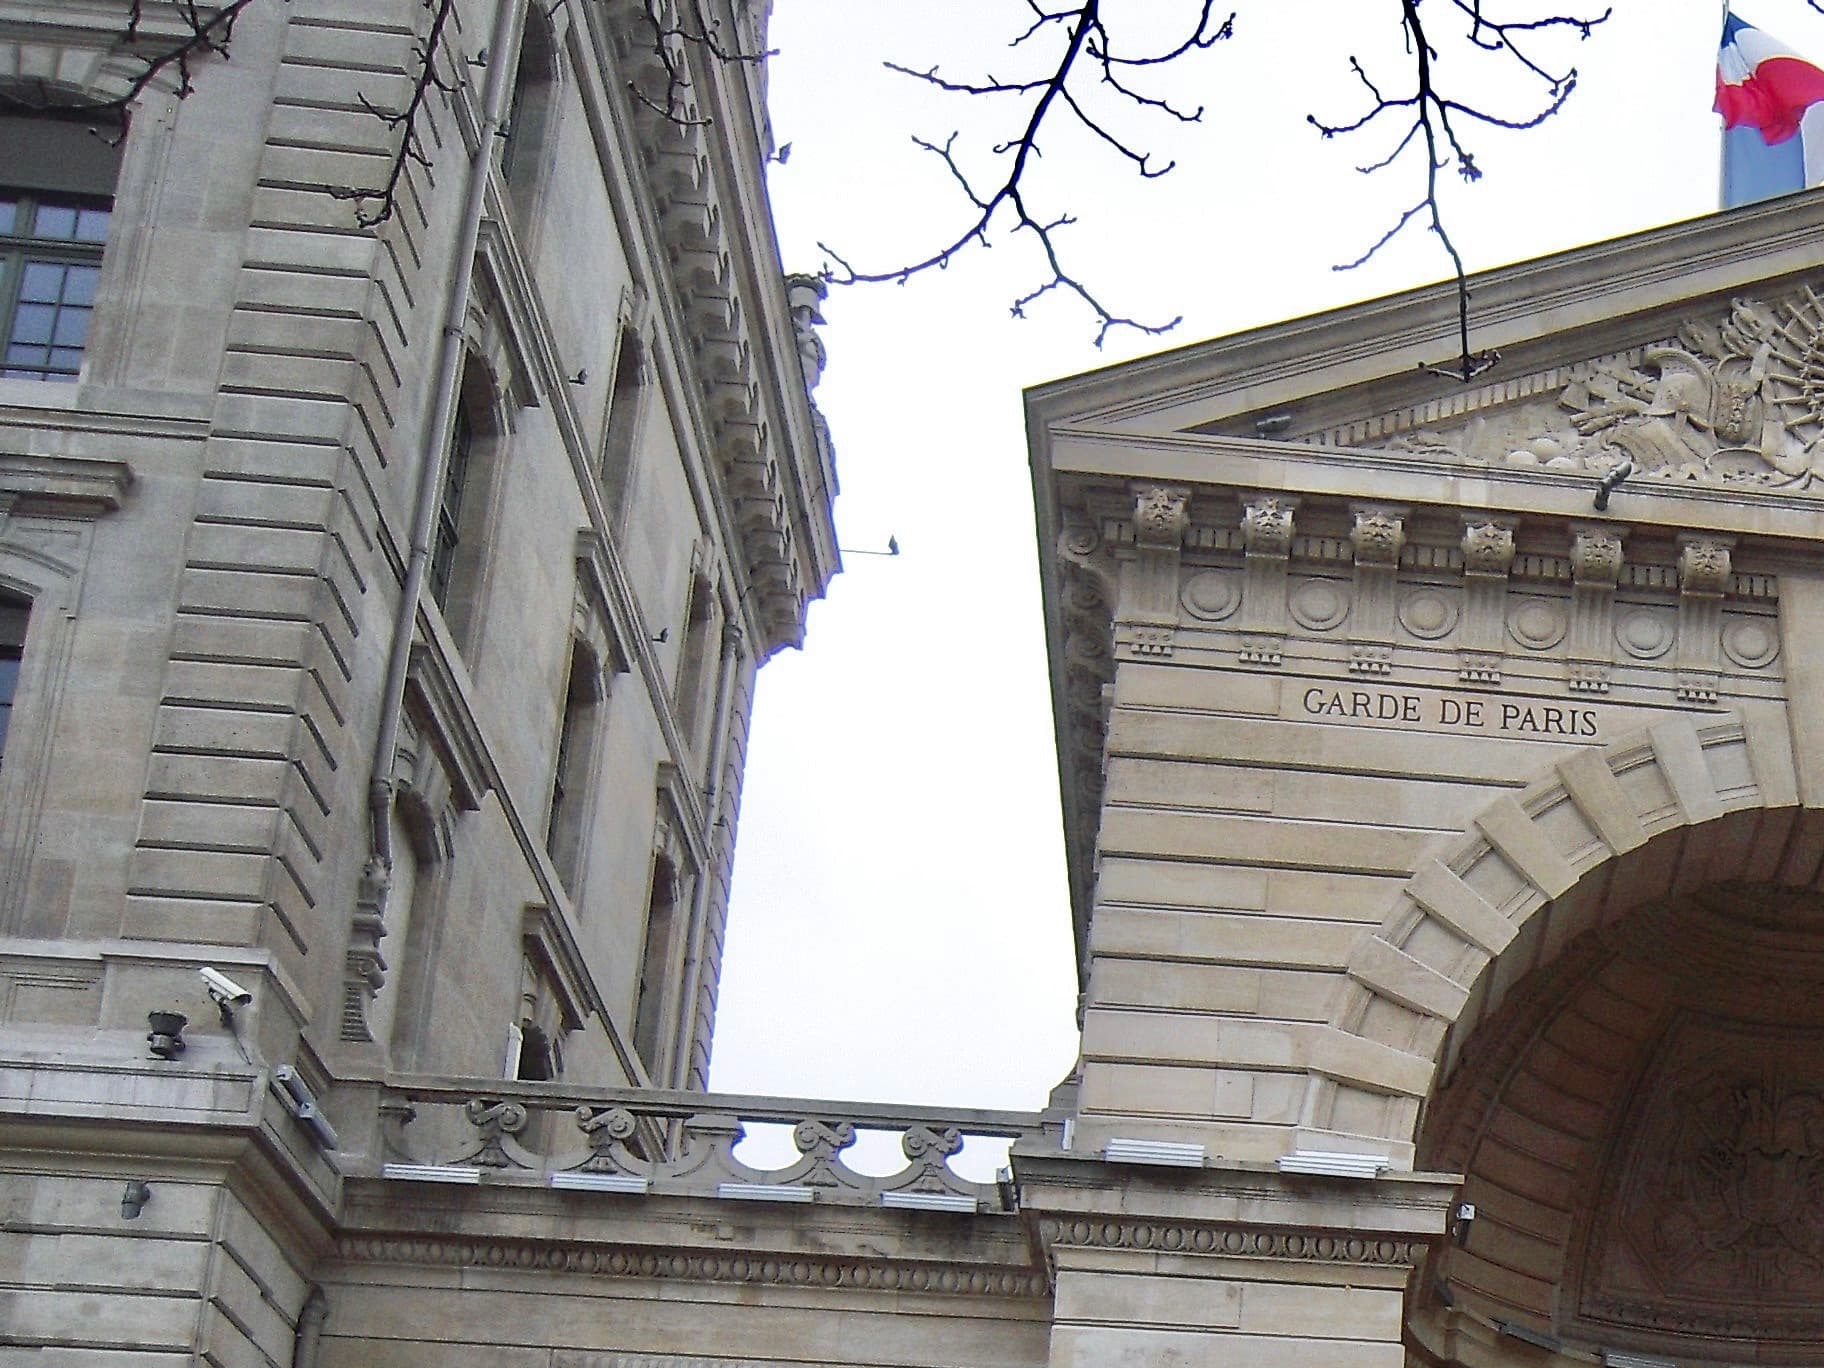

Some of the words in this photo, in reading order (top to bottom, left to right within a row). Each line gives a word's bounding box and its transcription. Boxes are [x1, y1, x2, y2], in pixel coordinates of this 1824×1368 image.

[1303, 688, 1421, 722] GARDE
[1440, 698, 1485, 727] DE
[1500, 703, 1597, 737] PARIS
